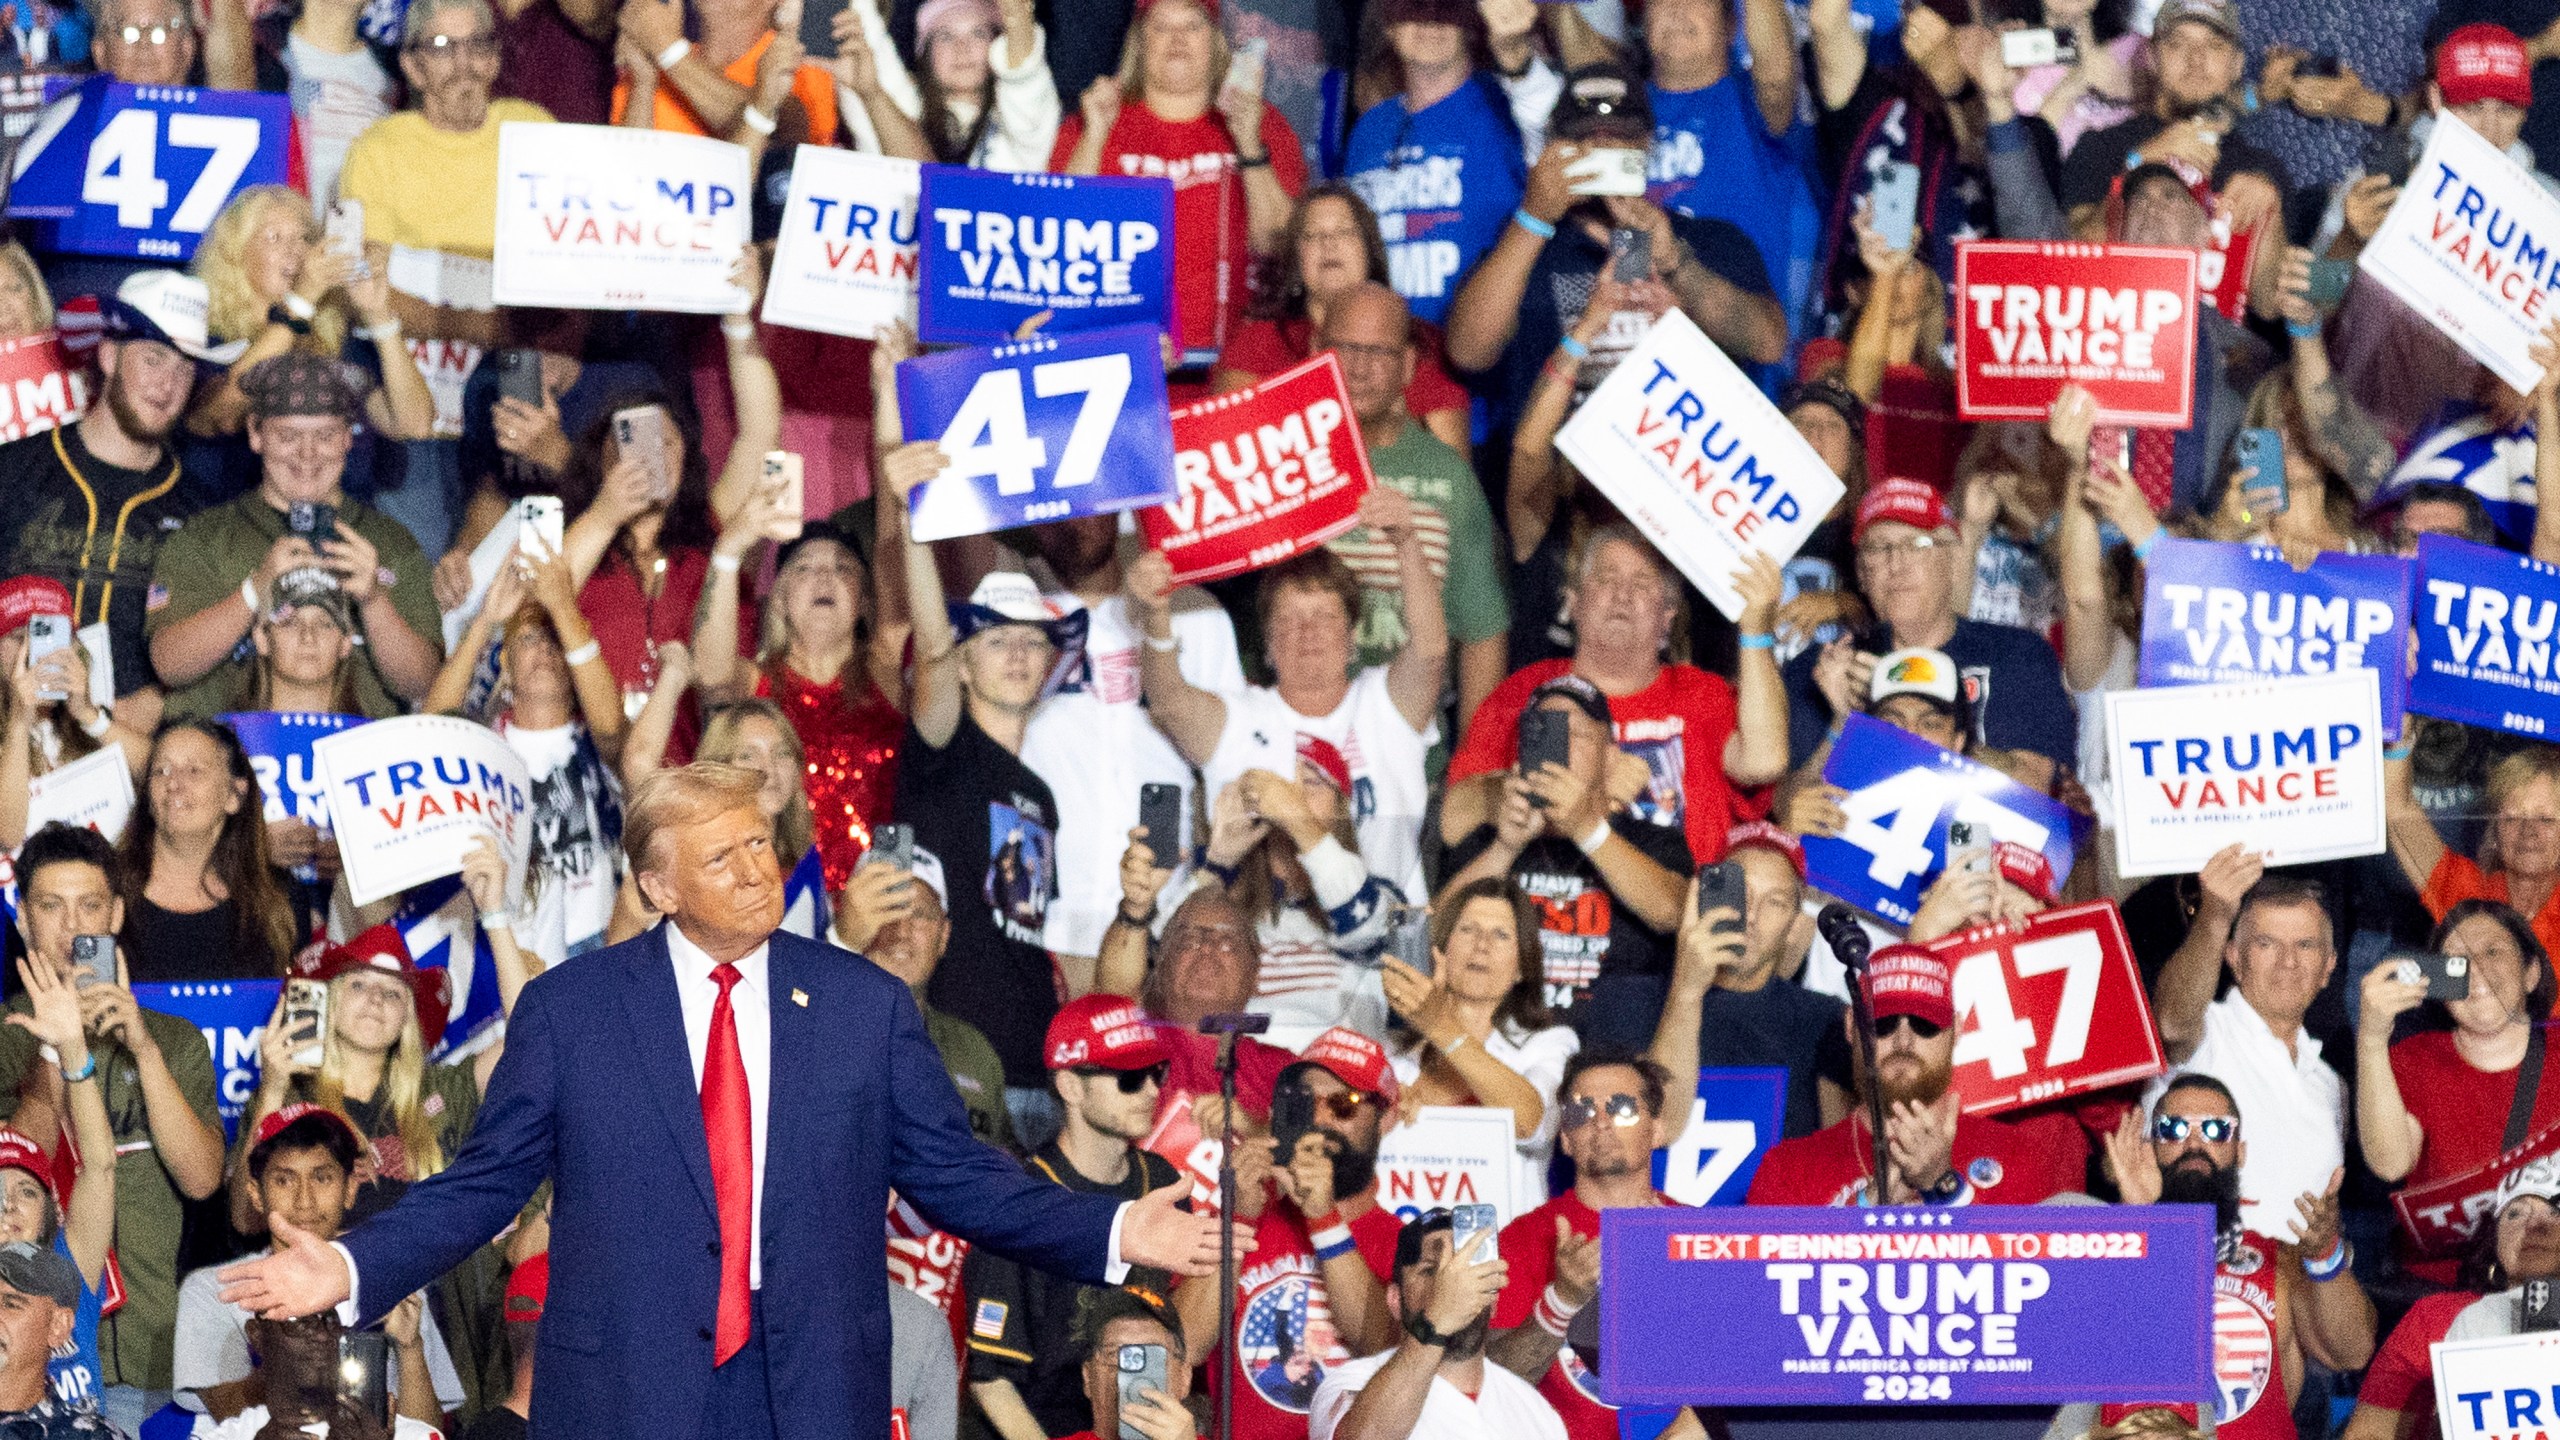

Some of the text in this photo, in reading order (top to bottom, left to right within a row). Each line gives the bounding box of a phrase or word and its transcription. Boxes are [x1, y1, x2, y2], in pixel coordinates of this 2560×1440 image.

[82, 108, 261, 234] 47
[517, 172, 735, 217] TRMP
[543, 214, 713, 250] VANCE
[809, 196, 920, 246] TRU
[934, 208, 1159, 262] TRUMP
[959, 251, 1133, 295] VANCE
[2431, 209, 2546, 320] VANCE
[1968, 283, 2184, 334] TRUMP
[1989, 326, 2155, 369] VANCE
[938, 352, 1133, 497] 47
[1642, 357, 1800, 525] TRUMP
[1161, 446, 1337, 532] VANCE
[1634, 406, 1766, 543] VANCE
[2163, 583, 2395, 645] TRUMP
[2186, 627, 2366, 675] VANCE
[2447, 624, 2560, 680] VAN
[2130, 722, 2362, 777] TRUMP
[344, 756, 525, 815] TRUMP
[2160, 768, 2338, 810] VANCE
[378, 789, 515, 846] VANCE
[1951, 926, 2104, 1081] 47
[1389, 1169, 1478, 1204] VAN
[1674, 1232, 2143, 1260] TEXT PENNSYLVANIA TO 88022
[1765, 1262, 2051, 1316] TRUMP
[1797, 1313, 2018, 1357] VANCE
[1782, 1358, 2033, 1374] MAKE AMERICA GREAT AGAIN!
[1863, 1374, 1952, 1401] 2024
[2457, 1384, 2560, 1432] TR
